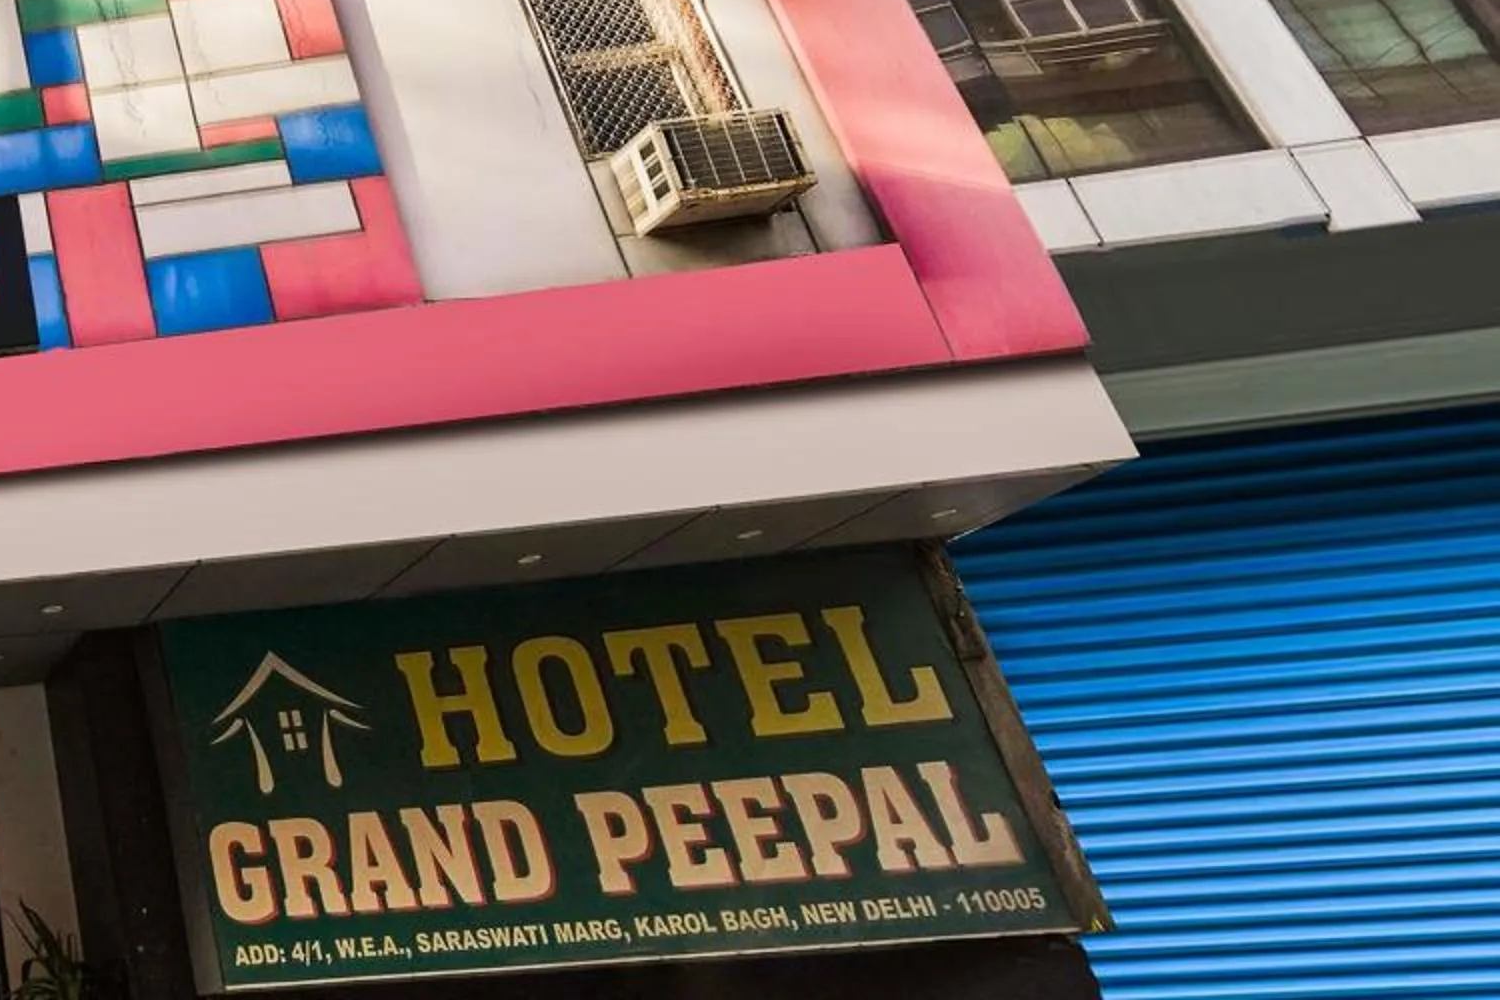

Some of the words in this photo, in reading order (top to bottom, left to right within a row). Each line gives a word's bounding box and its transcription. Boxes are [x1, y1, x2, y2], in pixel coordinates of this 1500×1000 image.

[394, 604, 954, 769] HOTEL
[208, 798, 558, 926] GRAND
[575, 759, 1027, 898] PEEPAL
[235, 943, 286, 967] ADD:
[290, 940, 332, 967] 4/1,
[334, 935, 412, 961] W.E.A.,
[415, 925, 548, 954] SARASWATI
[553, 917, 631, 945] MARG,
[633, 911, 717, 938] KAROL
[721, 905, 800, 932] BAGH,
[801, 899, 857, 926] NEW
[864, 894, 938, 921] DELHI
[955, 886, 1048, 915] 110005
